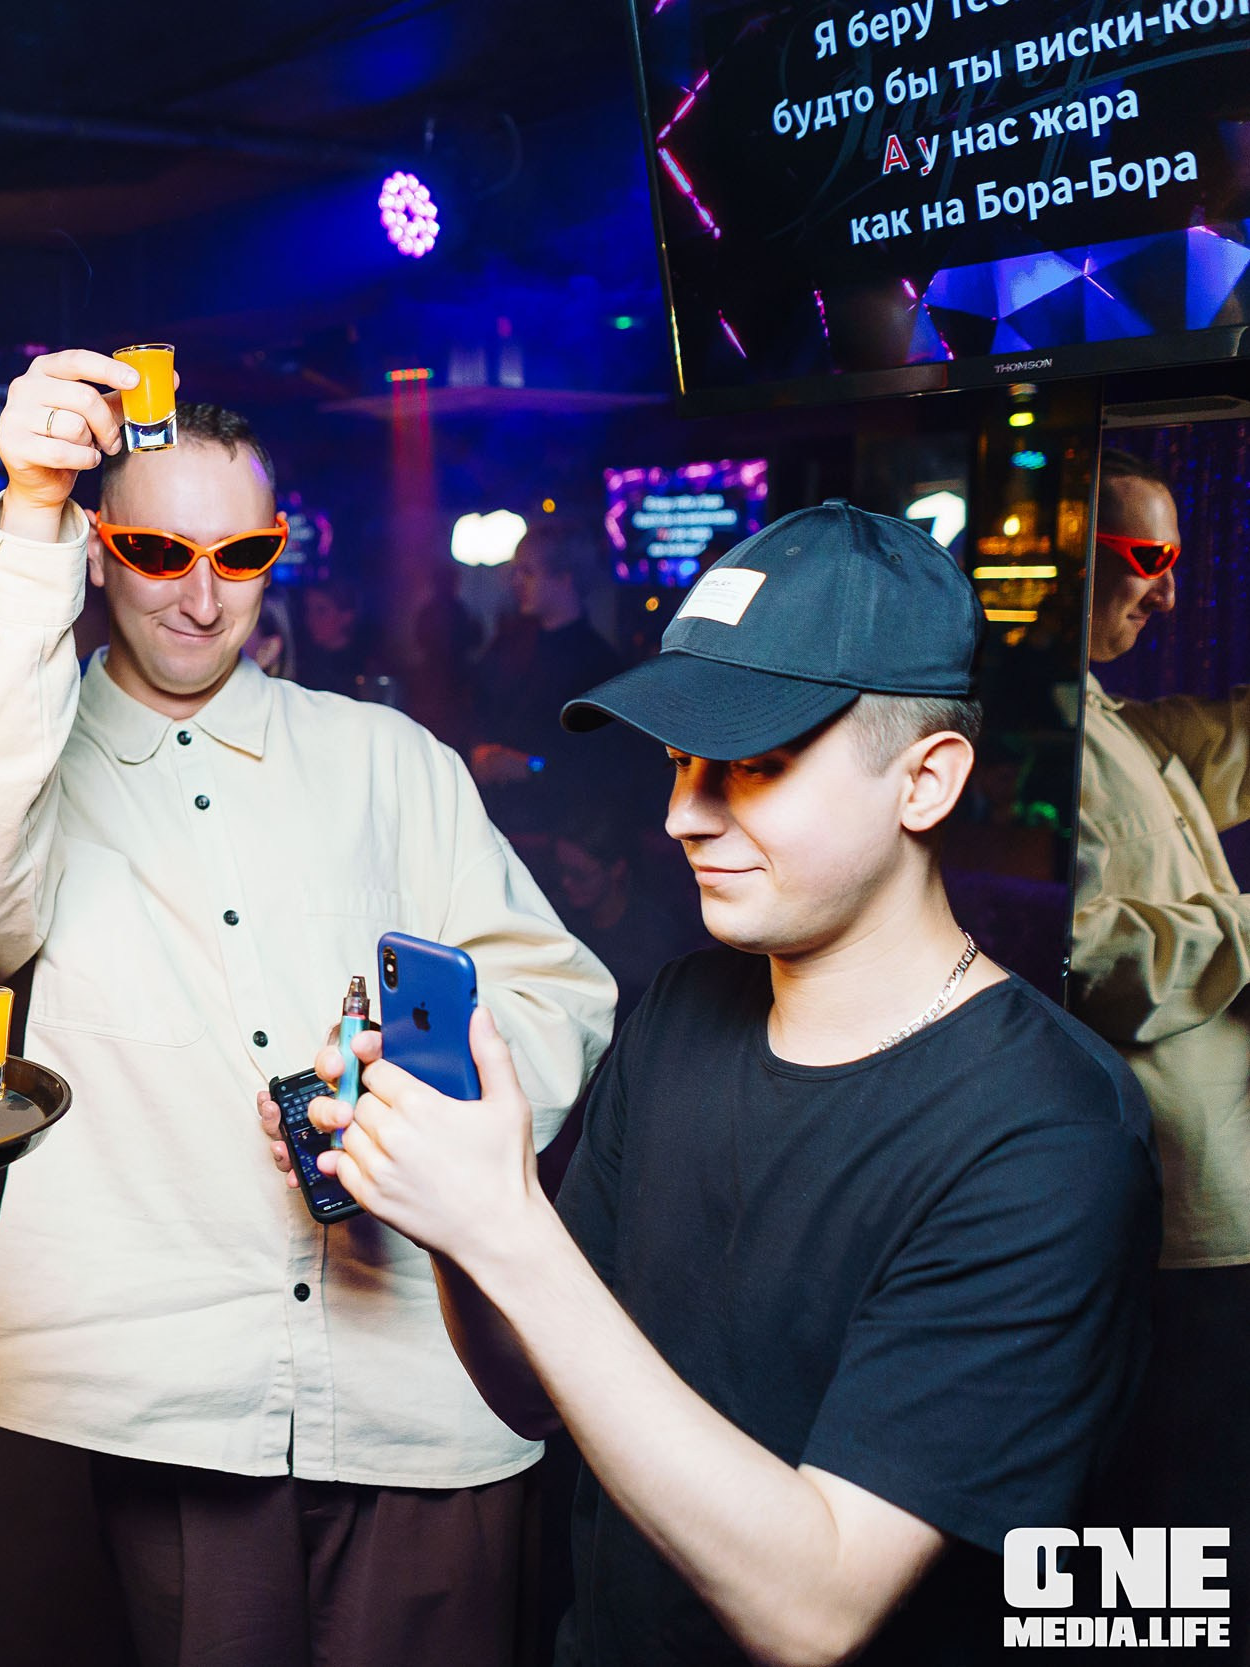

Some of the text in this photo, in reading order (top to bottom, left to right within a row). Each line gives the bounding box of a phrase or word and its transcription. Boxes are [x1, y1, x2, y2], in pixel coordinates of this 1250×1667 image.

[814, 18, 838, 60] Я
[847, 0, 934, 48] беру
[773, 86, 874, 140] будто
[884, 67, 938, 105] бы
[949, 49, 1002, 89] ты
[882, 89, 1140, 176] А у нас жара
[850, 151, 1199, 245] как на Бора-Бора
[993, 358, 1053, 374] THOMSON
